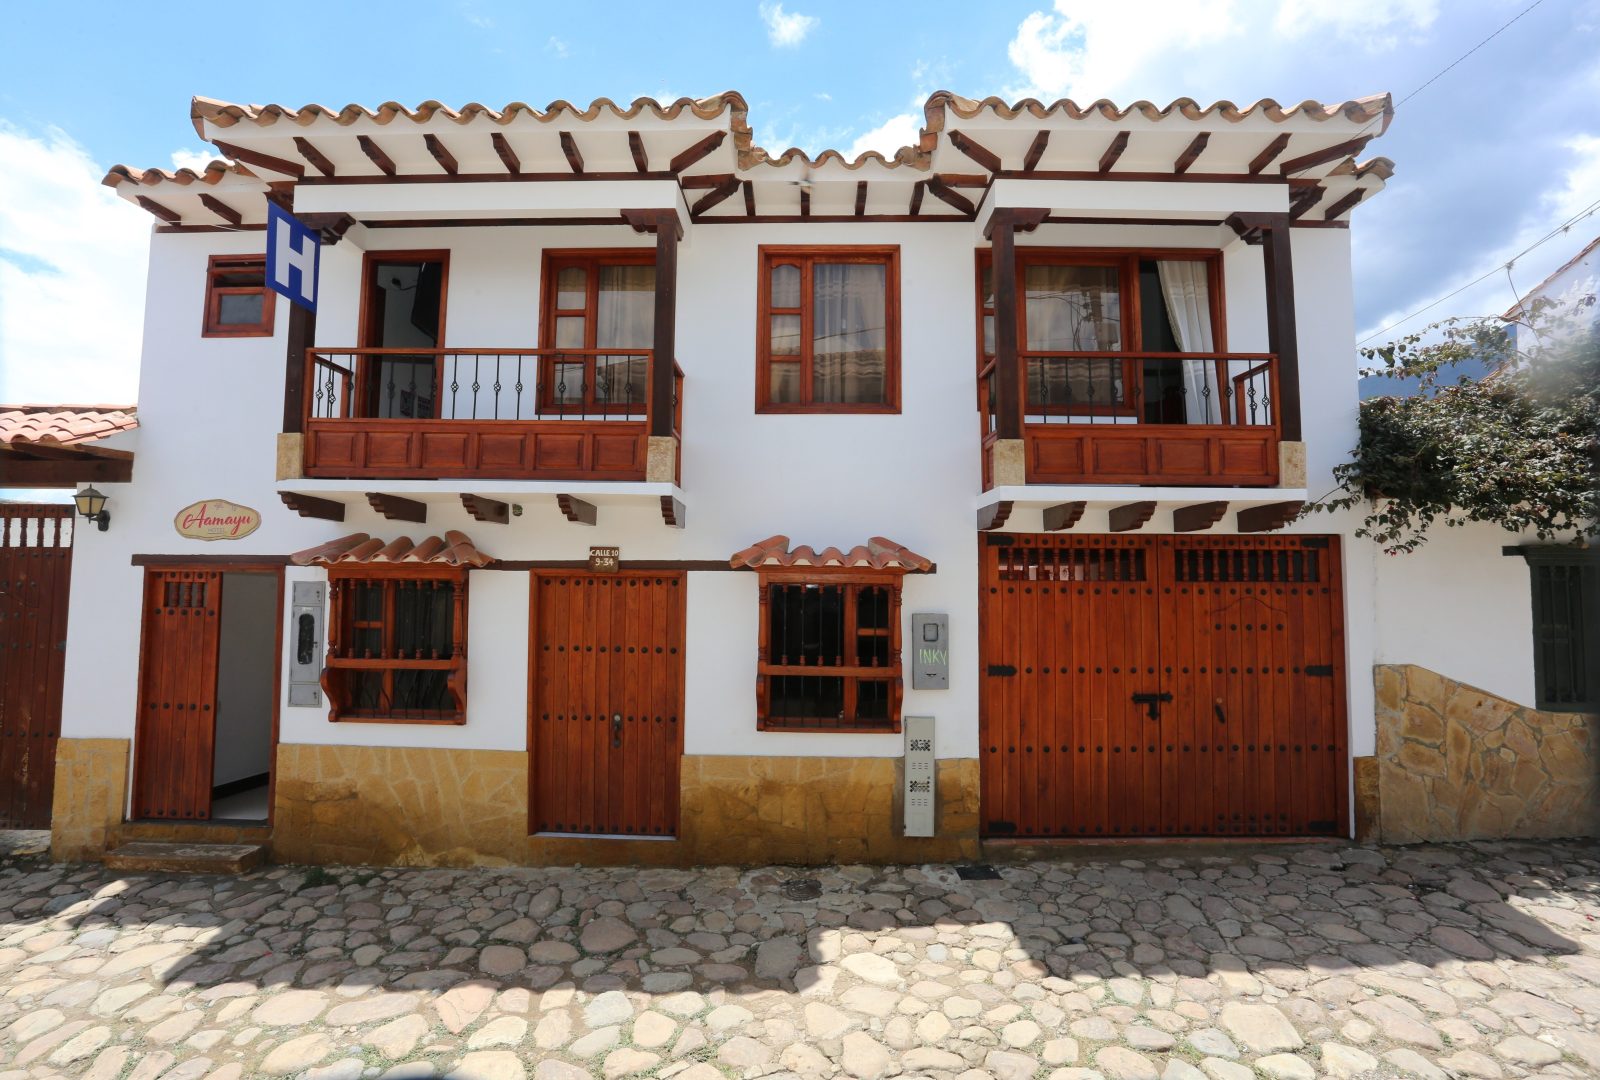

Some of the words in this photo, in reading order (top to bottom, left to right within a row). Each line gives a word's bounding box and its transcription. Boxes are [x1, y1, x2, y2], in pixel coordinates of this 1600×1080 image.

[275, 216, 315, 303] H
[182, 503, 252, 535] Aamayu
[595, 557, 614, 566] 9-34
